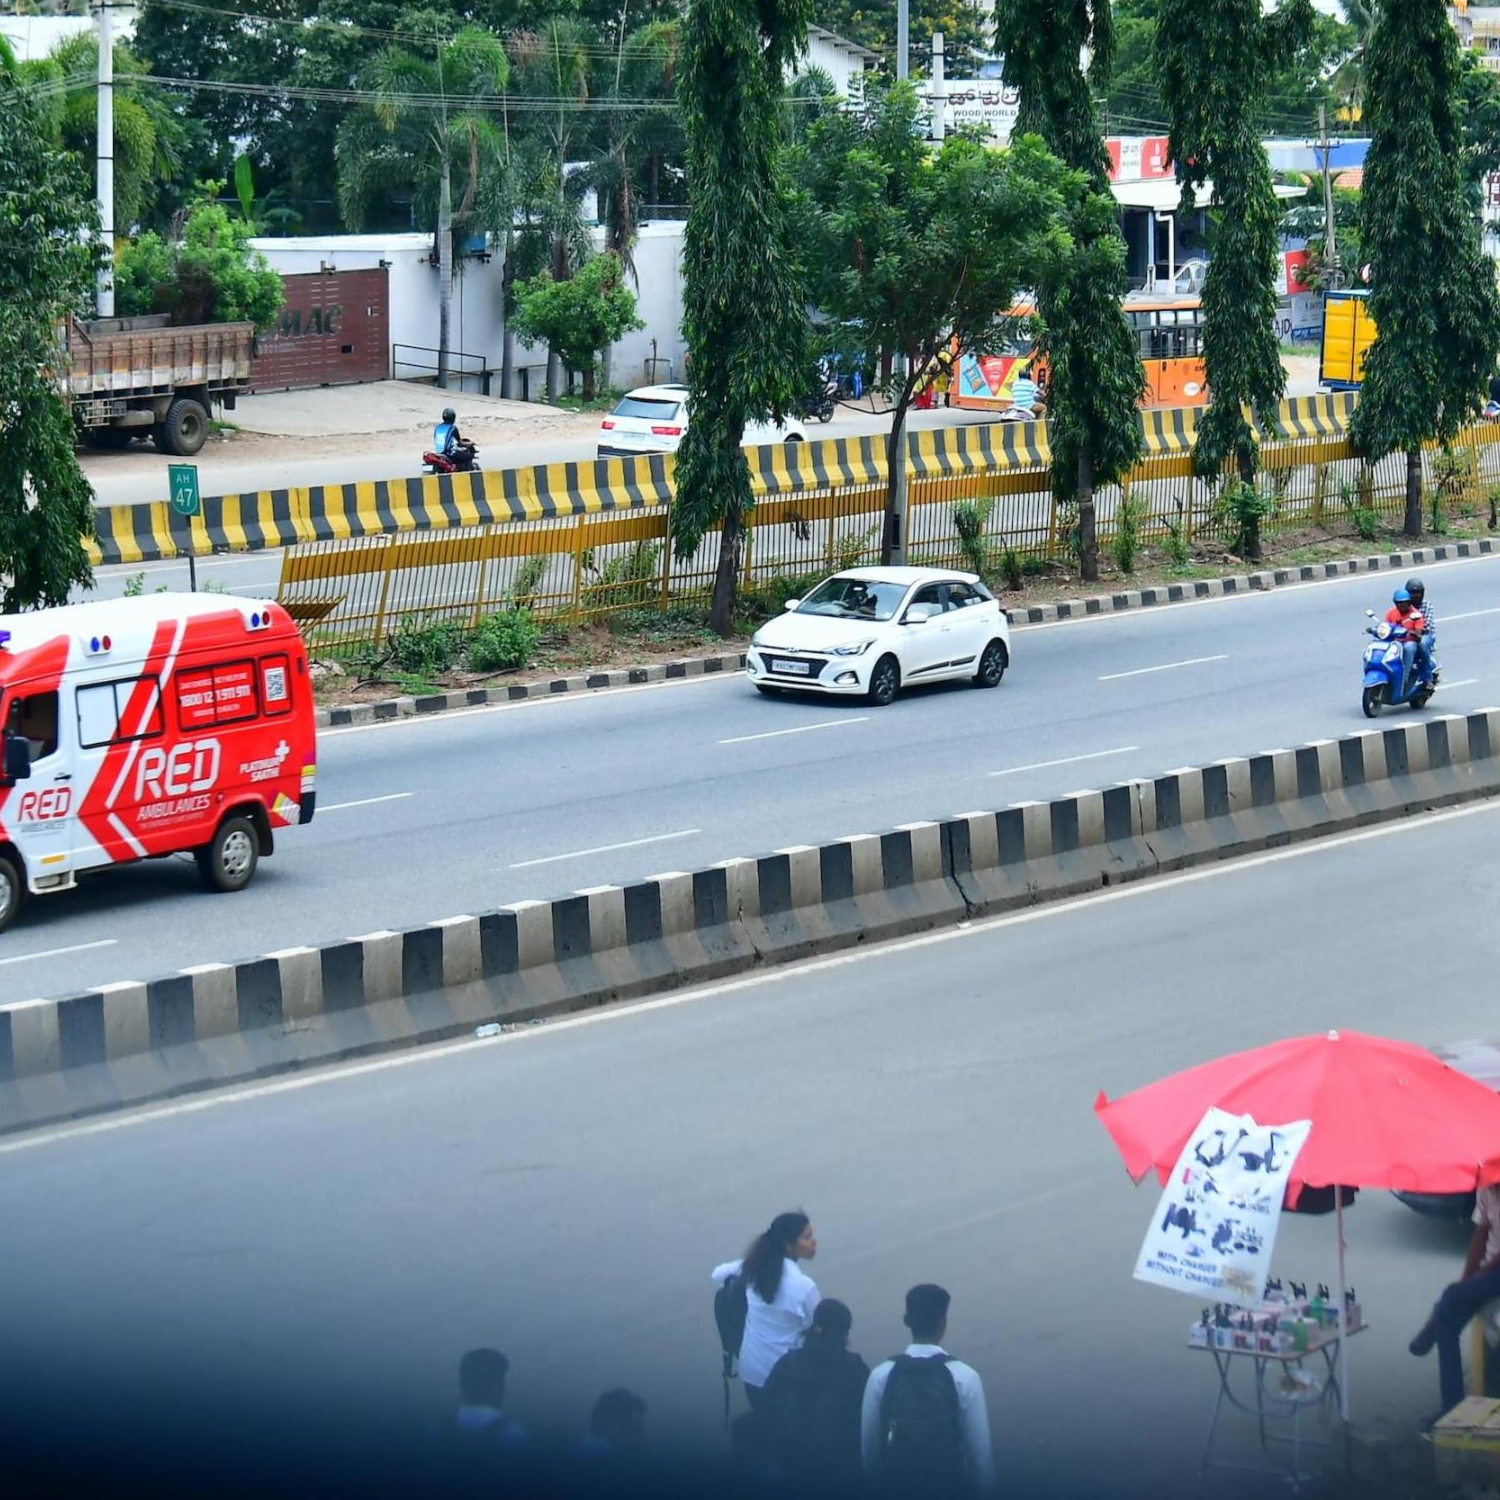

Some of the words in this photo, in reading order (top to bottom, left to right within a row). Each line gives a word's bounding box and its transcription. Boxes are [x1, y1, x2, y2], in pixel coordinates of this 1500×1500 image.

[176, 474, 190, 484] AH
[176, 488, 193, 507] 47
[134, 737, 221, 802] RED
[17, 786, 72, 822] RED
[136, 793, 213, 822] AMBULANCES
